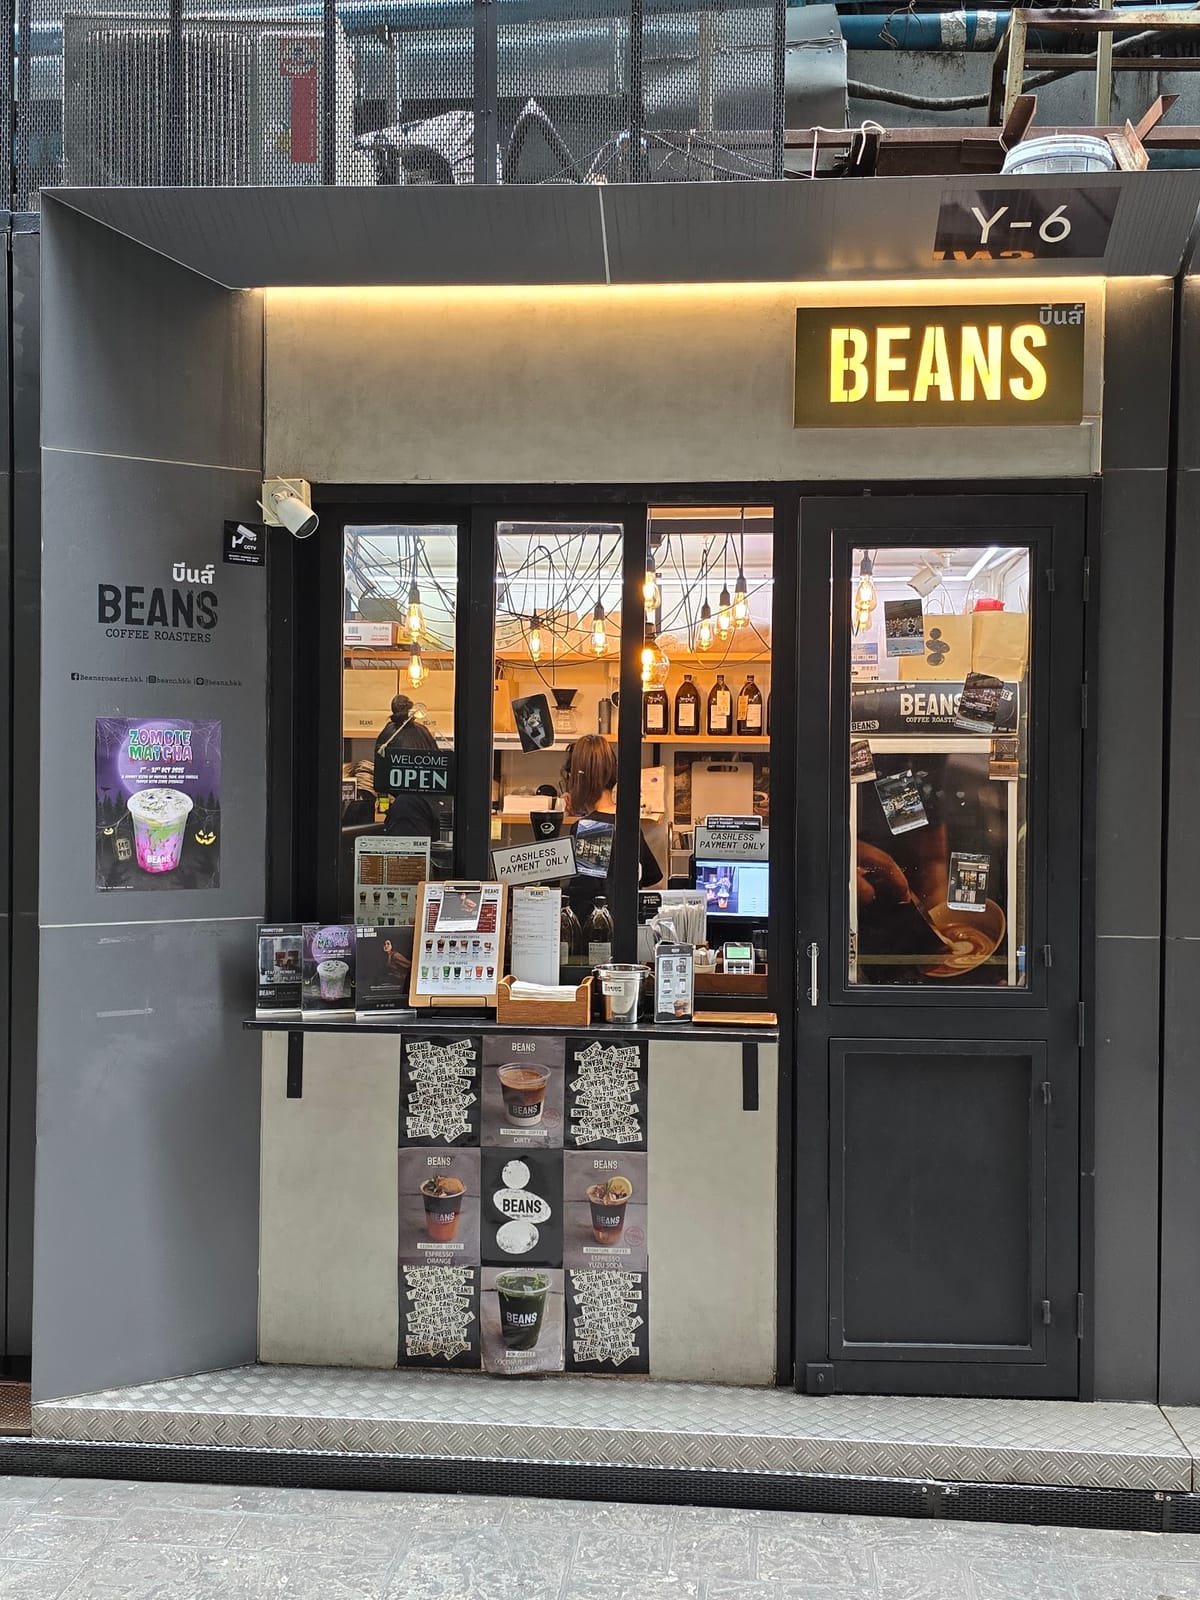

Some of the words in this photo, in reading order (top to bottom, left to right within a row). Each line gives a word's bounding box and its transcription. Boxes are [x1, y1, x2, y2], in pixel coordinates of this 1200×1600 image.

[971, 204, 1072, 245] Y-6
[1038, 303, 1085, 326] บีนส์
[829, 324, 1049, 404] BEANS
[172, 562, 216, 585] บีนส์
[98, 583, 219, 630] BEANS
[105, 628, 149, 640] COFFEE
[154, 630, 212, 643] ROASTERS
[128, 728, 192, 746] ZOMBIE
[128, 744, 193, 763] MATCHA
[390, 754, 449, 767] WELCOME
[389, 768, 448, 790] OPEN
[711, 832, 755, 842] CASHLESS
[699, 841, 738, 850] PAYMENT
[742, 842, 766, 851] ONLY
[510, 847, 557, 863] CASHLESS
[500, 859, 541, 875] PAYMENT
[545, 855, 570, 867] ONLY
[258, 989, 275, 997] BEANS
[511, 1042, 536, 1052] BEANS
[512, 1104, 538, 1114] BEANS
[427, 1156, 451, 1166] BEANS
[593, 1160, 618, 1169] BEANS
[502, 1198, 542, 1214] BEANS
[596, 1216, 620, 1225] BEANS
[506, 1311, 538, 1324] BEANS
